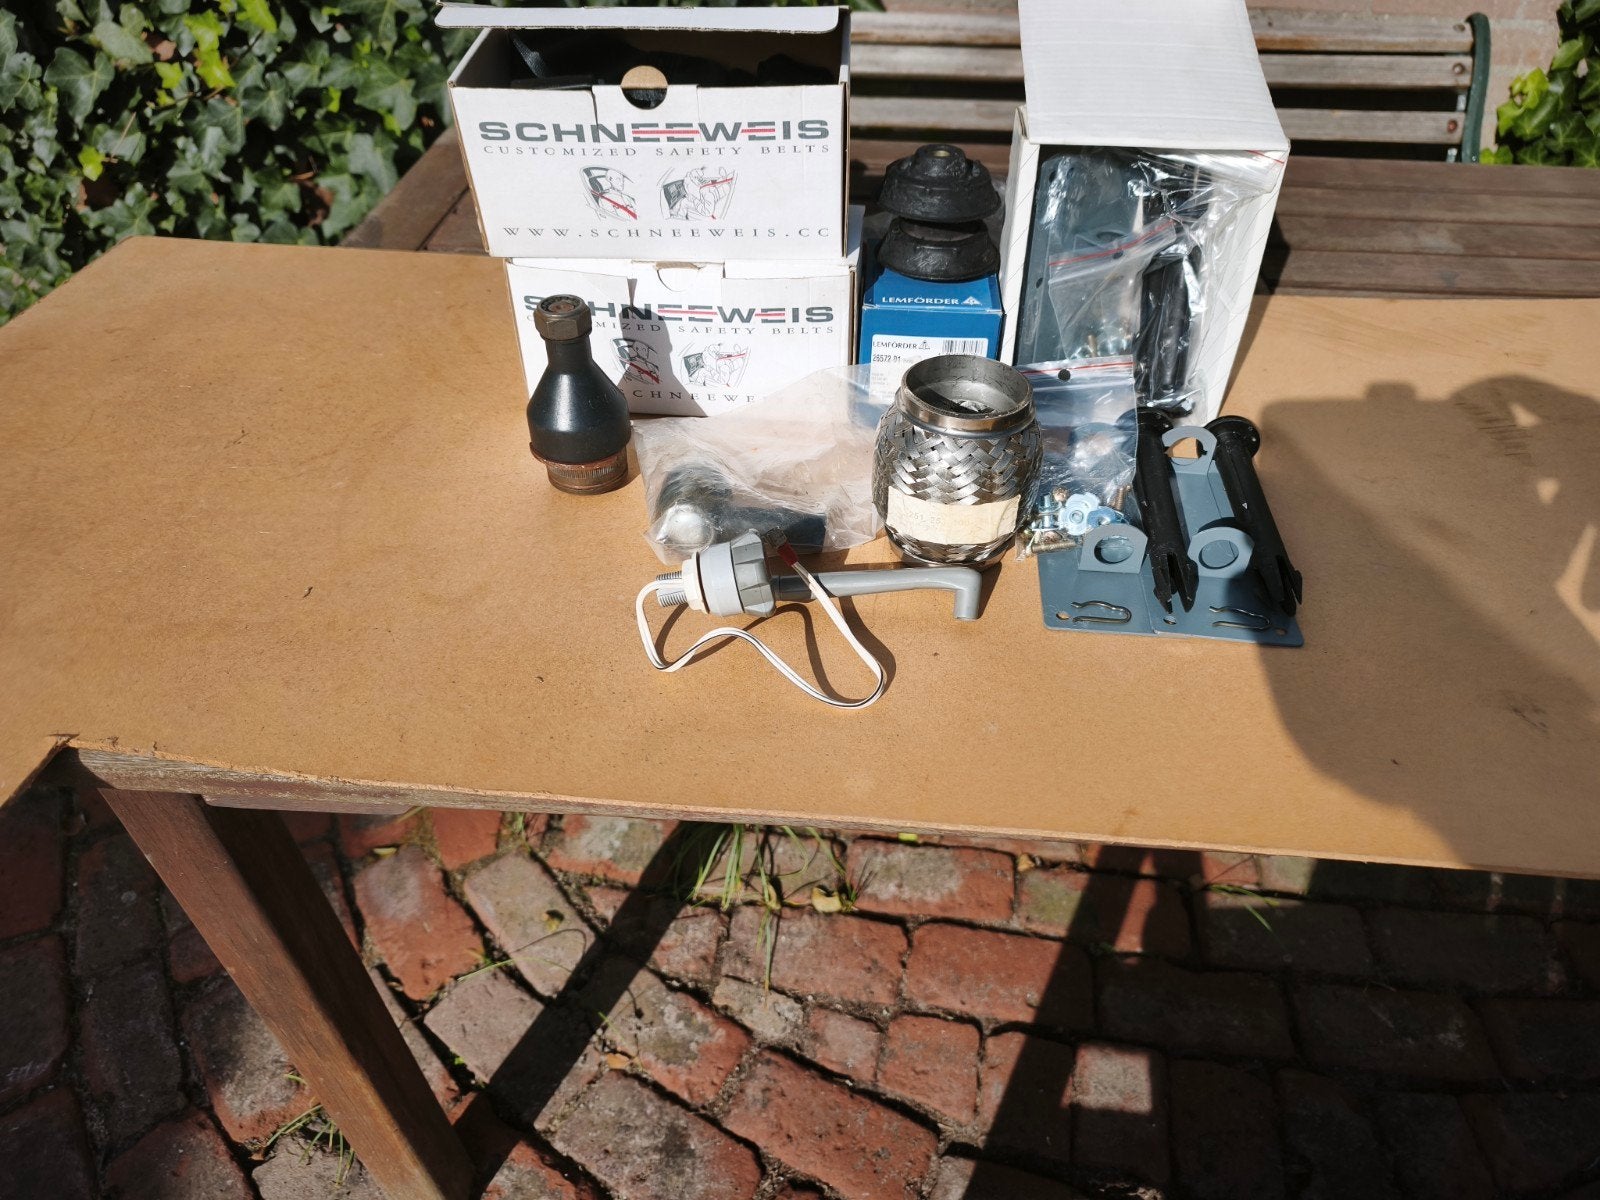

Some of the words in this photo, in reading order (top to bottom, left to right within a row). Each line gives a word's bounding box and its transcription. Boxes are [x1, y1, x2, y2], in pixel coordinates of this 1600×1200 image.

[478, 119, 830, 143] SCHNEEWEIS
[483, 145, 638, 157] CUSTOMIZED
[655, 145, 743, 157] SAFETY
[760, 144, 830, 155] BELTS
[502, 226, 830, 239] WWW.SCHNEEWEIS.CC
[523, 295, 835, 324] SHNEEWEIS
[677, 325, 756, 336] SAFETY
[772, 326, 835, 335] BELTS
